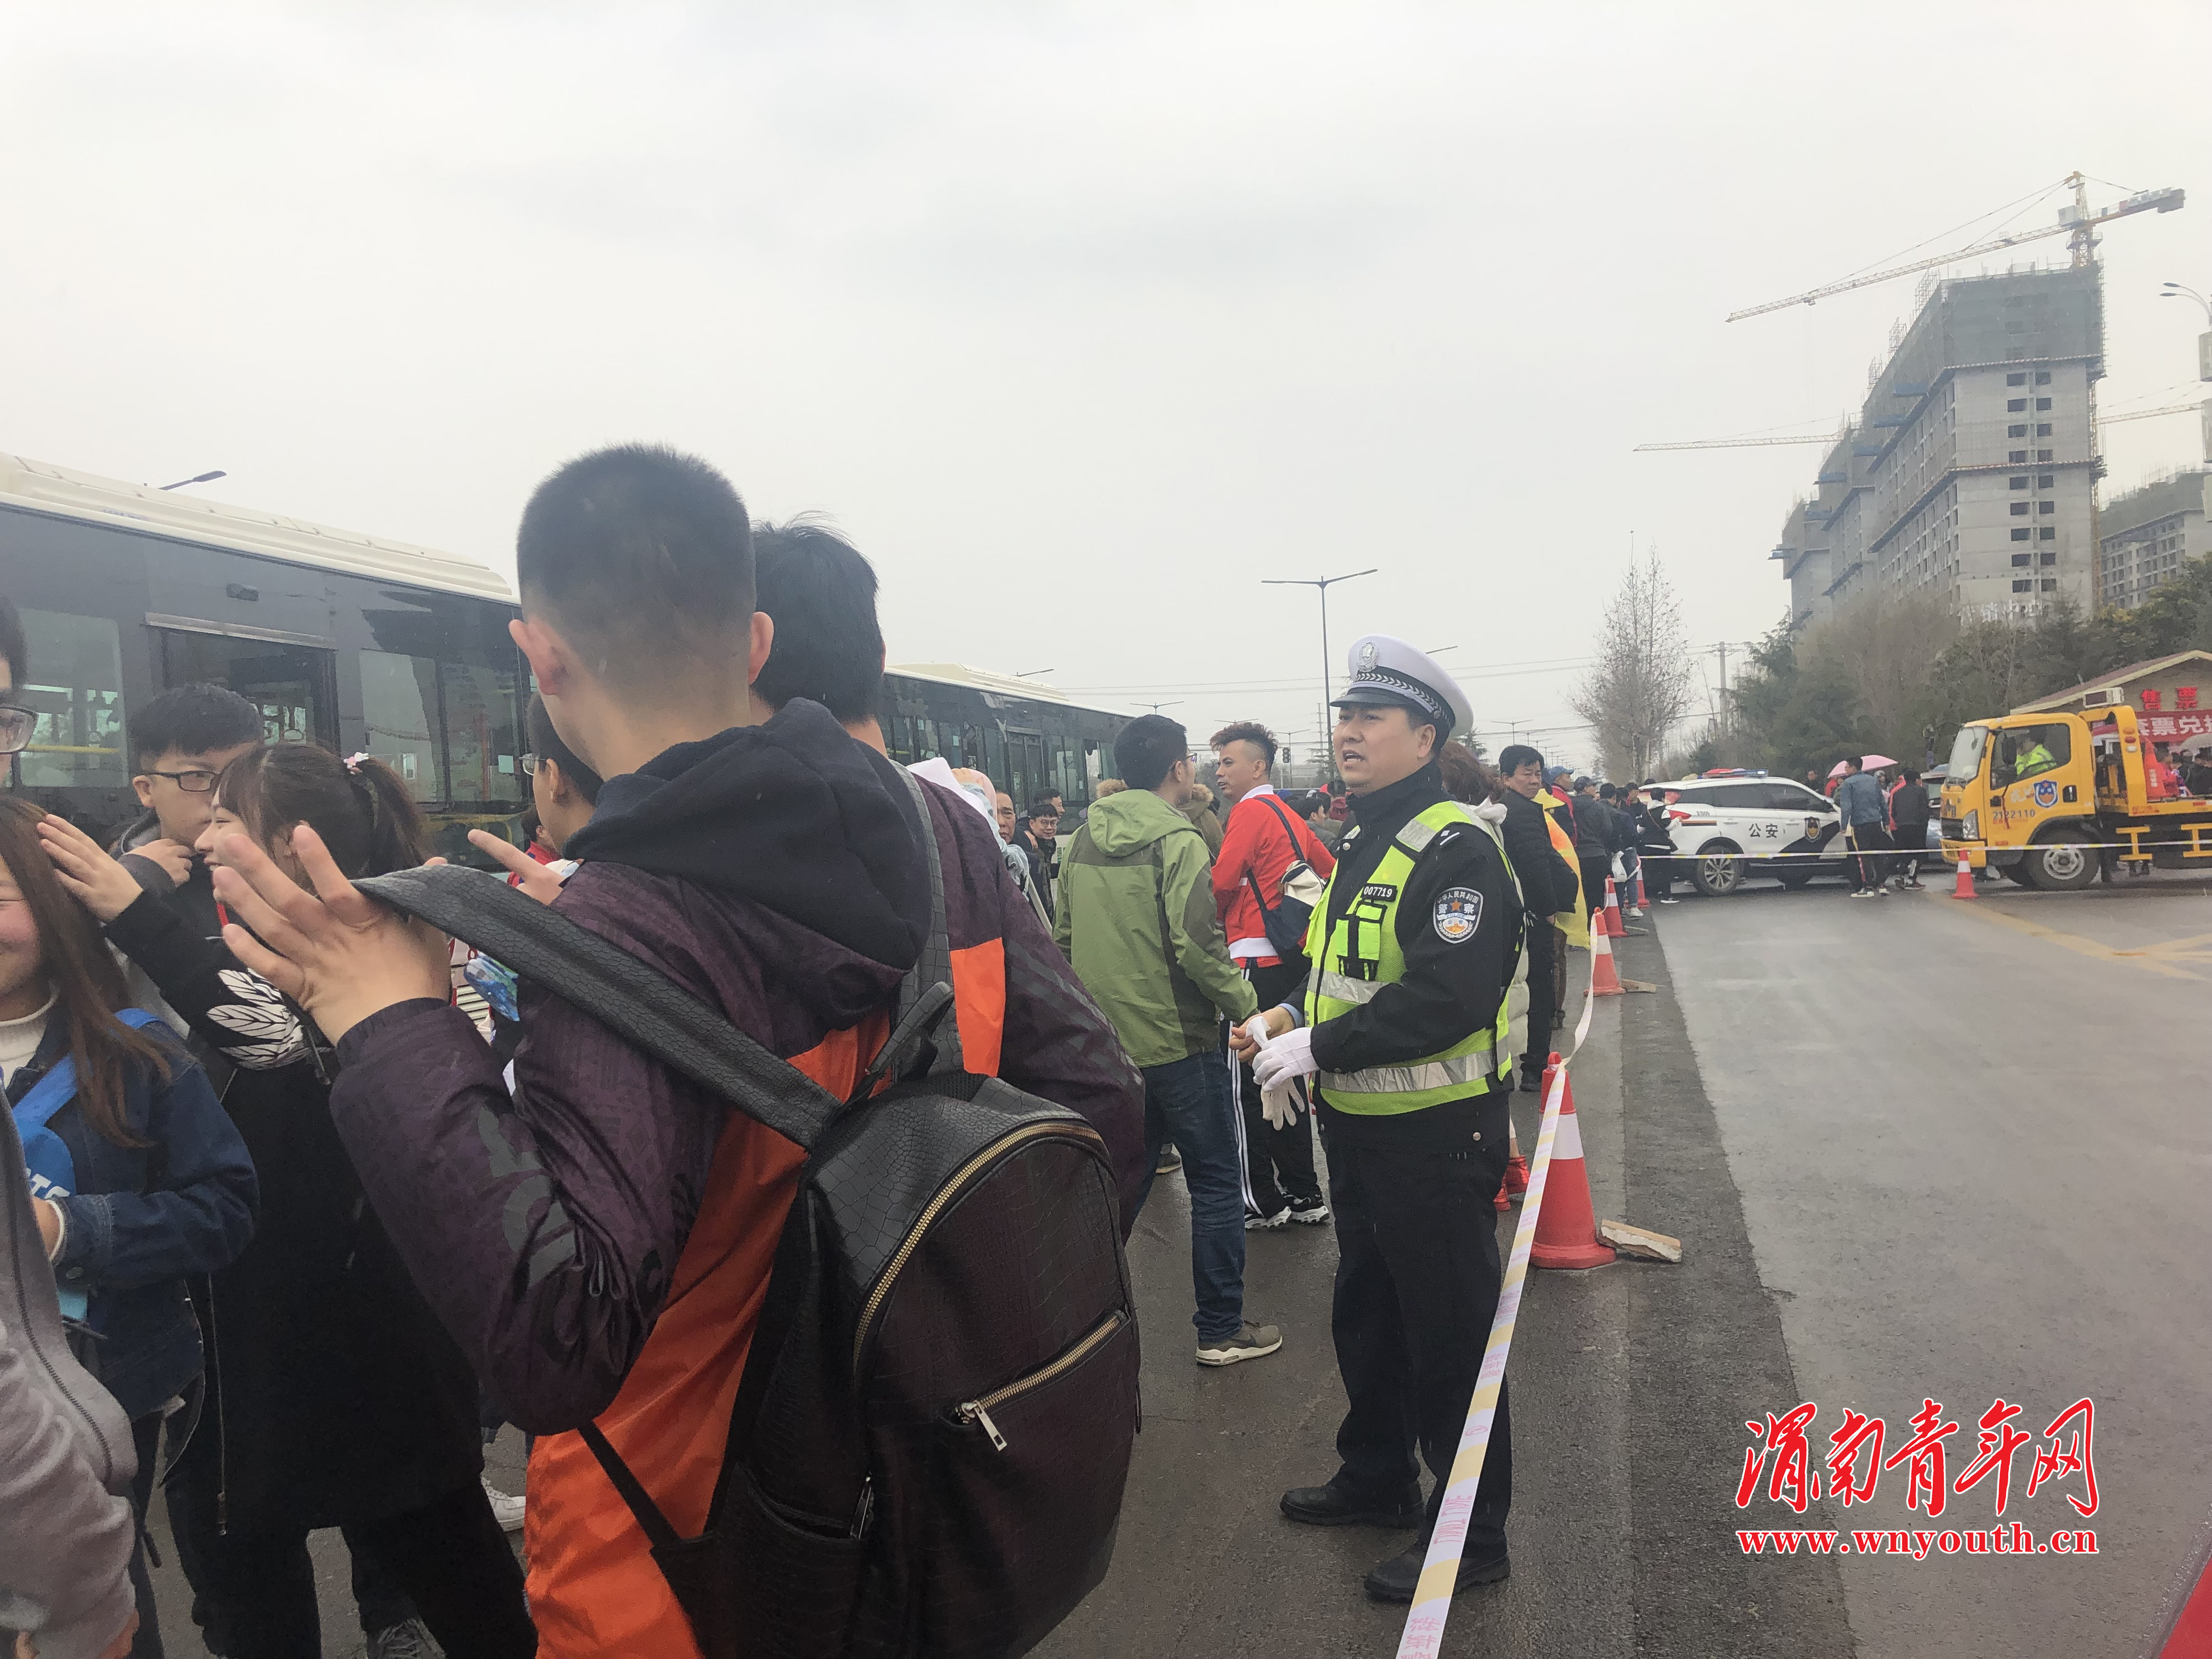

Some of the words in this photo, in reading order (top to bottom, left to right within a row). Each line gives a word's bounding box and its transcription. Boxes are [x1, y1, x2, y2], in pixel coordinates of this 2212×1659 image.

[2141, 686, 2198, 710] 售票
[1748, 823, 1778, 838] 公安
[1363, 886, 1393, 898] 007719
[1437, 890, 1479, 904] 中华人民共和国
[1438, 903, 1475, 915] 警察
